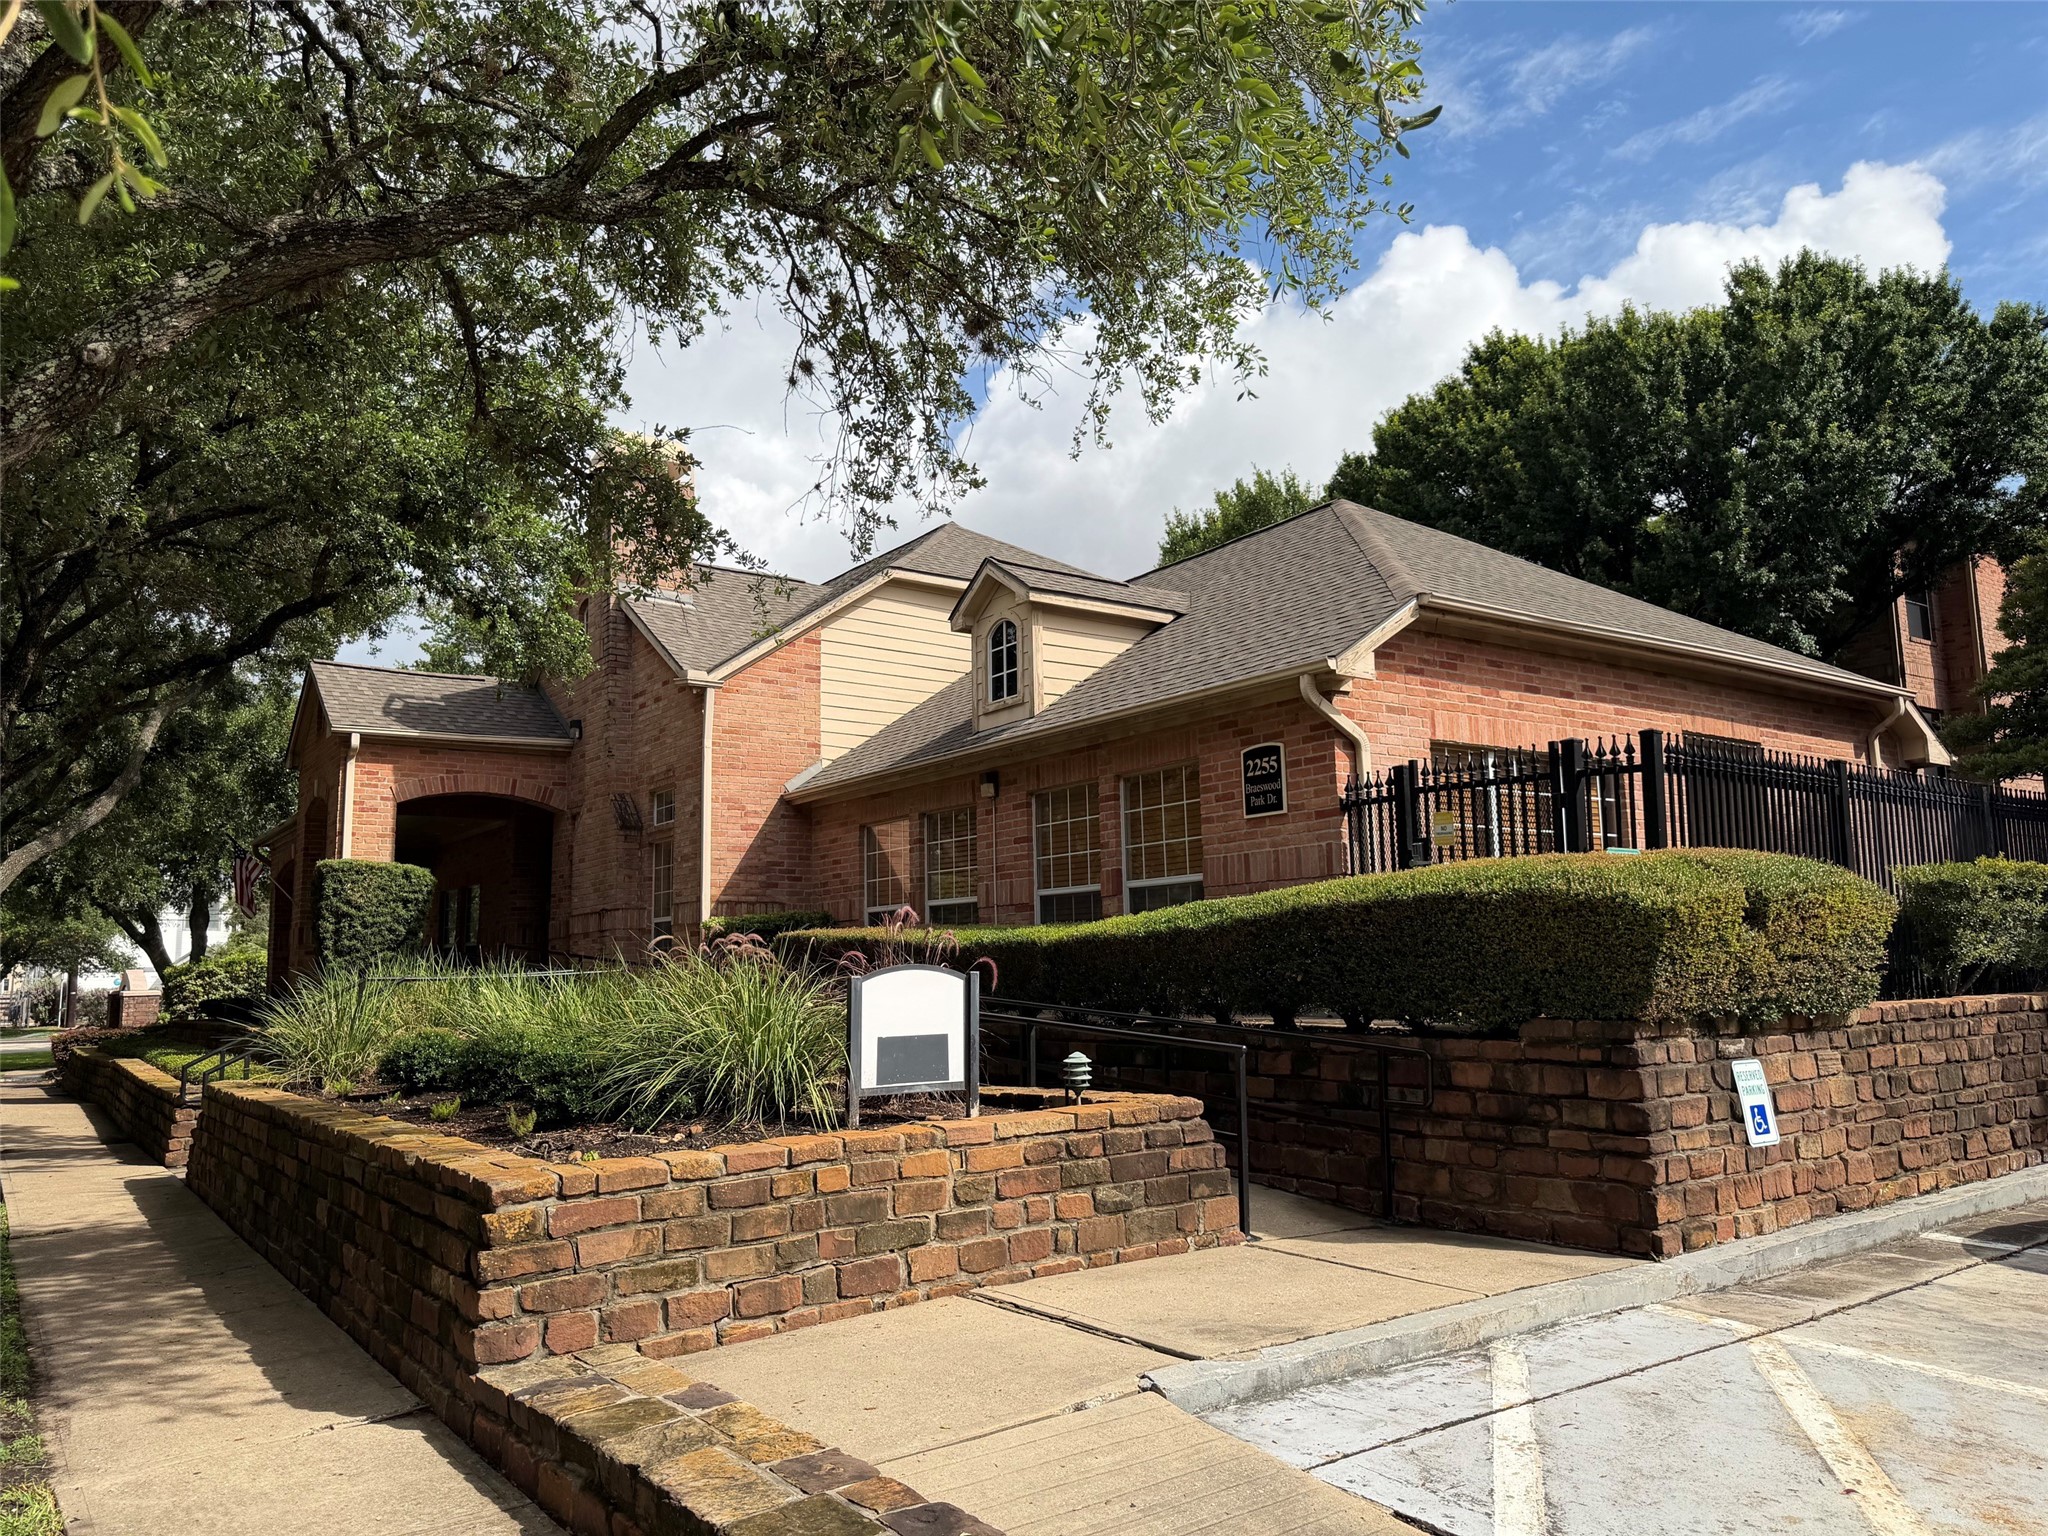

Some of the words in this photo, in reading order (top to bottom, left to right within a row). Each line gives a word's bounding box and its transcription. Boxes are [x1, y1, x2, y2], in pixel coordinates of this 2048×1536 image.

[1246, 755, 1278, 777] 2255
[1245, 779, 1281, 794] Braeswood
[1250, 795, 1265, 807] Park
[1267, 793, 1278, 804] Dr.
[1735, 1069, 1764, 1082] RESERVED
[1741, 1084, 1766, 1096] PARKING
